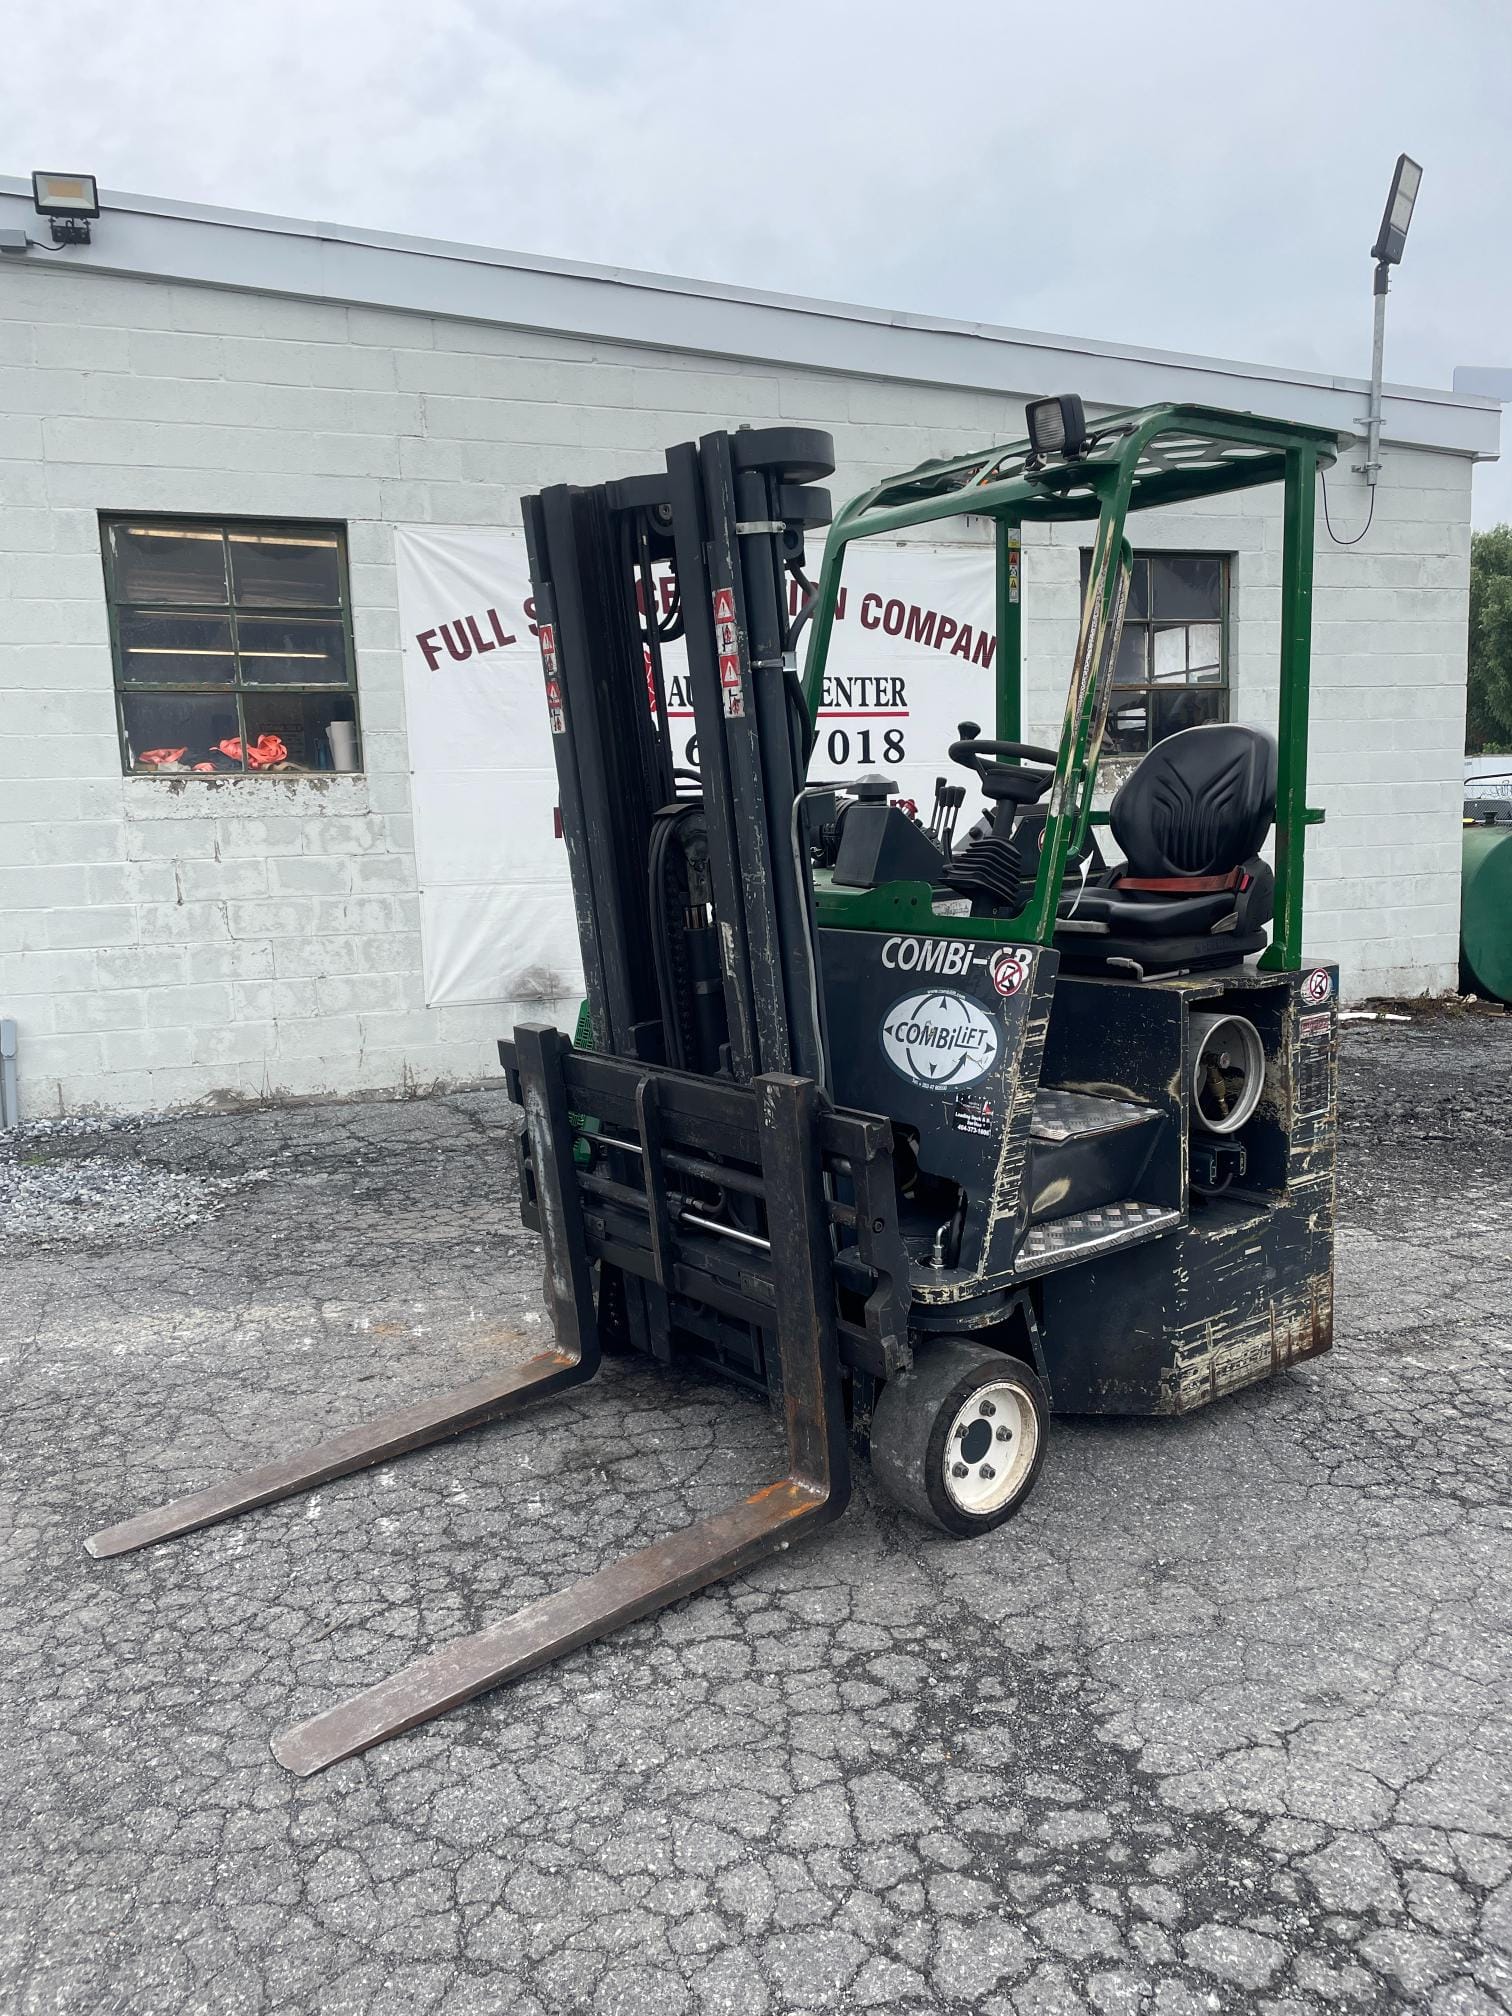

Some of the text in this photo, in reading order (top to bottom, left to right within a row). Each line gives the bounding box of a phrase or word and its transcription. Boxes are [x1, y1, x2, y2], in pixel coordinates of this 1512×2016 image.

[415, 608, 518, 672] FULL
[860, 592, 997, 670] COMPAN
[818, 676, 908, 707] ENTER
